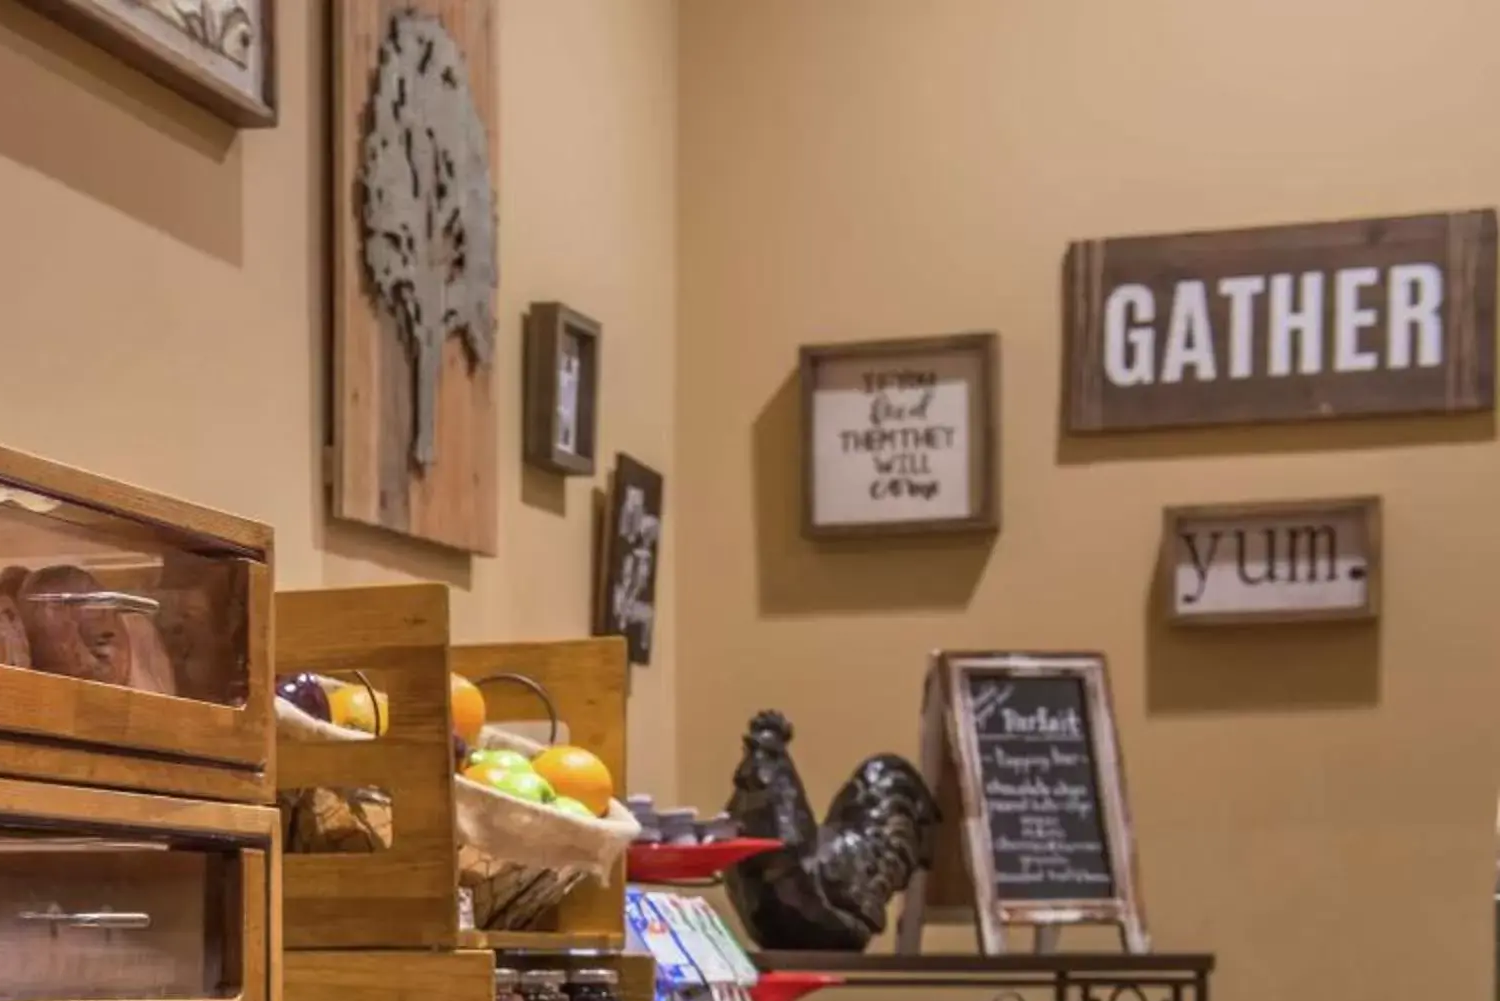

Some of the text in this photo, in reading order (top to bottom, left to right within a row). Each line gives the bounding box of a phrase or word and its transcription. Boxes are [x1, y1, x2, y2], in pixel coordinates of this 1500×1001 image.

[1104, 262, 1442, 387] GATHER
[839, 426, 955, 452] THEM THEY
[873, 453, 932, 475] WILL
[1179, 525, 1367, 604] yum.
